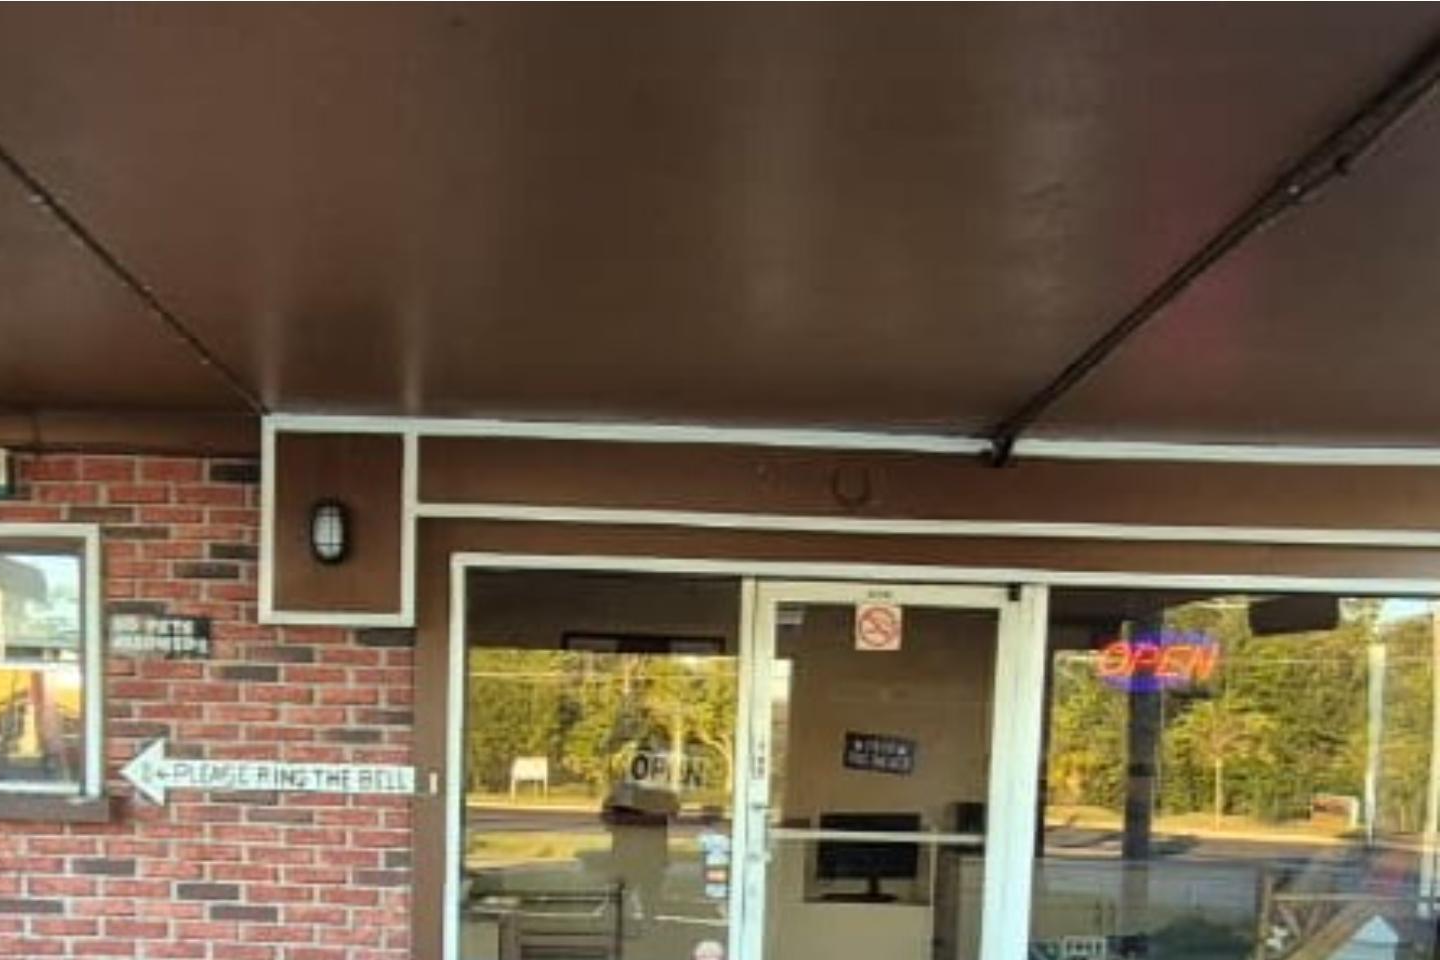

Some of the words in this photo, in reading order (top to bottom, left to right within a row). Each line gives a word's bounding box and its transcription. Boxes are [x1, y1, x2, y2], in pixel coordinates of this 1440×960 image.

[1097, 641, 1220, 680] OPEN
[173, 763, 250, 787] PLEASE
[257, 765, 308, 788] RING
[312, 768, 352, 789] THE
[359, 769, 410, 791] BELL
